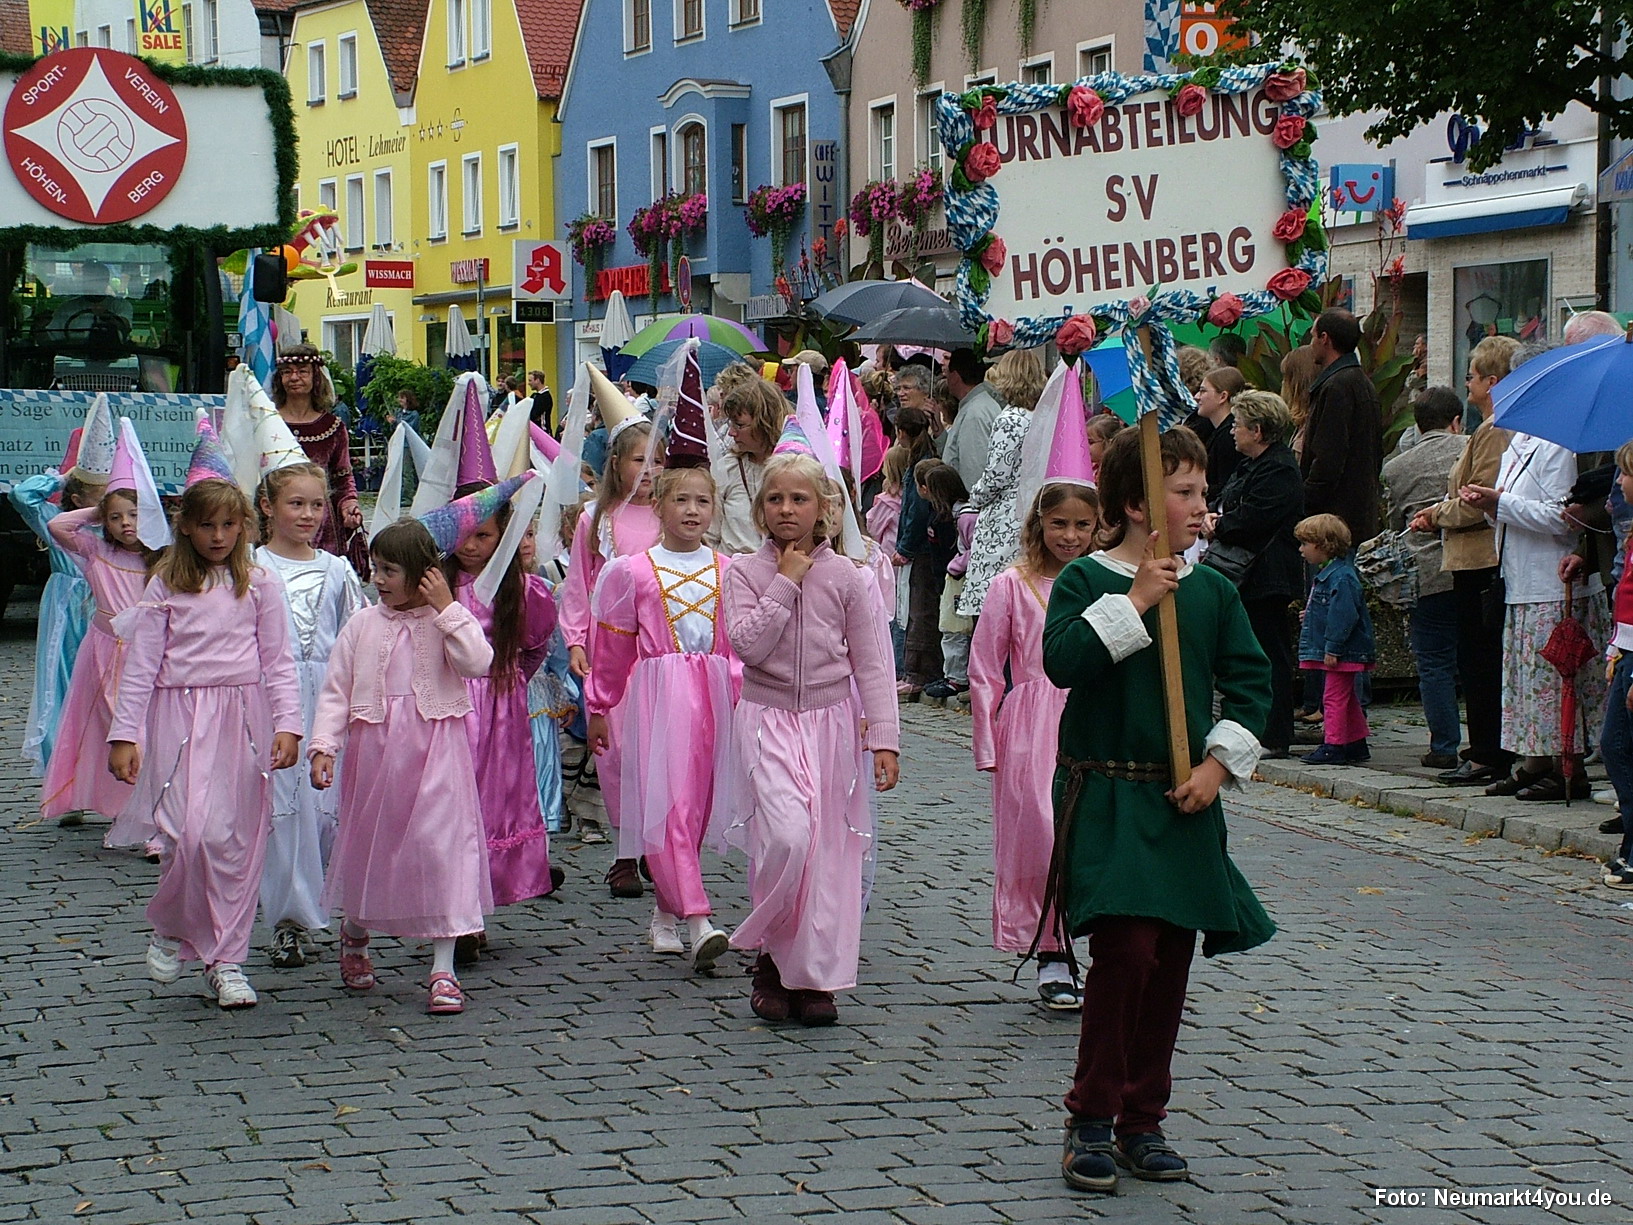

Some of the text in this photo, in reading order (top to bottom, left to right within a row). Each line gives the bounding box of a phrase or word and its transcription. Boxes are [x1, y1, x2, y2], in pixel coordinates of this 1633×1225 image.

[142, 34, 182, 50] SALE
[21, 64, 68, 105] SPORT-
[124, 66, 169, 115] VEREIN
[975, 86, 1280, 164] URNABTEILUNG
[327, 130, 407, 168] HOTEL Lehmeier
[814, 140, 836, 161] CAFÉ
[20, 156, 68, 205] HÖHEN-
[127, 170, 165, 204] BERG
[1462, 165, 1547, 188] Schnäppchenmarkt
[367, 269, 412, 280] WISSMACH
[1011, 226, 1256, 301] HÖHENBERG
[11, 401, 53, 421] Sage
[45, 436, 61, 452] in
